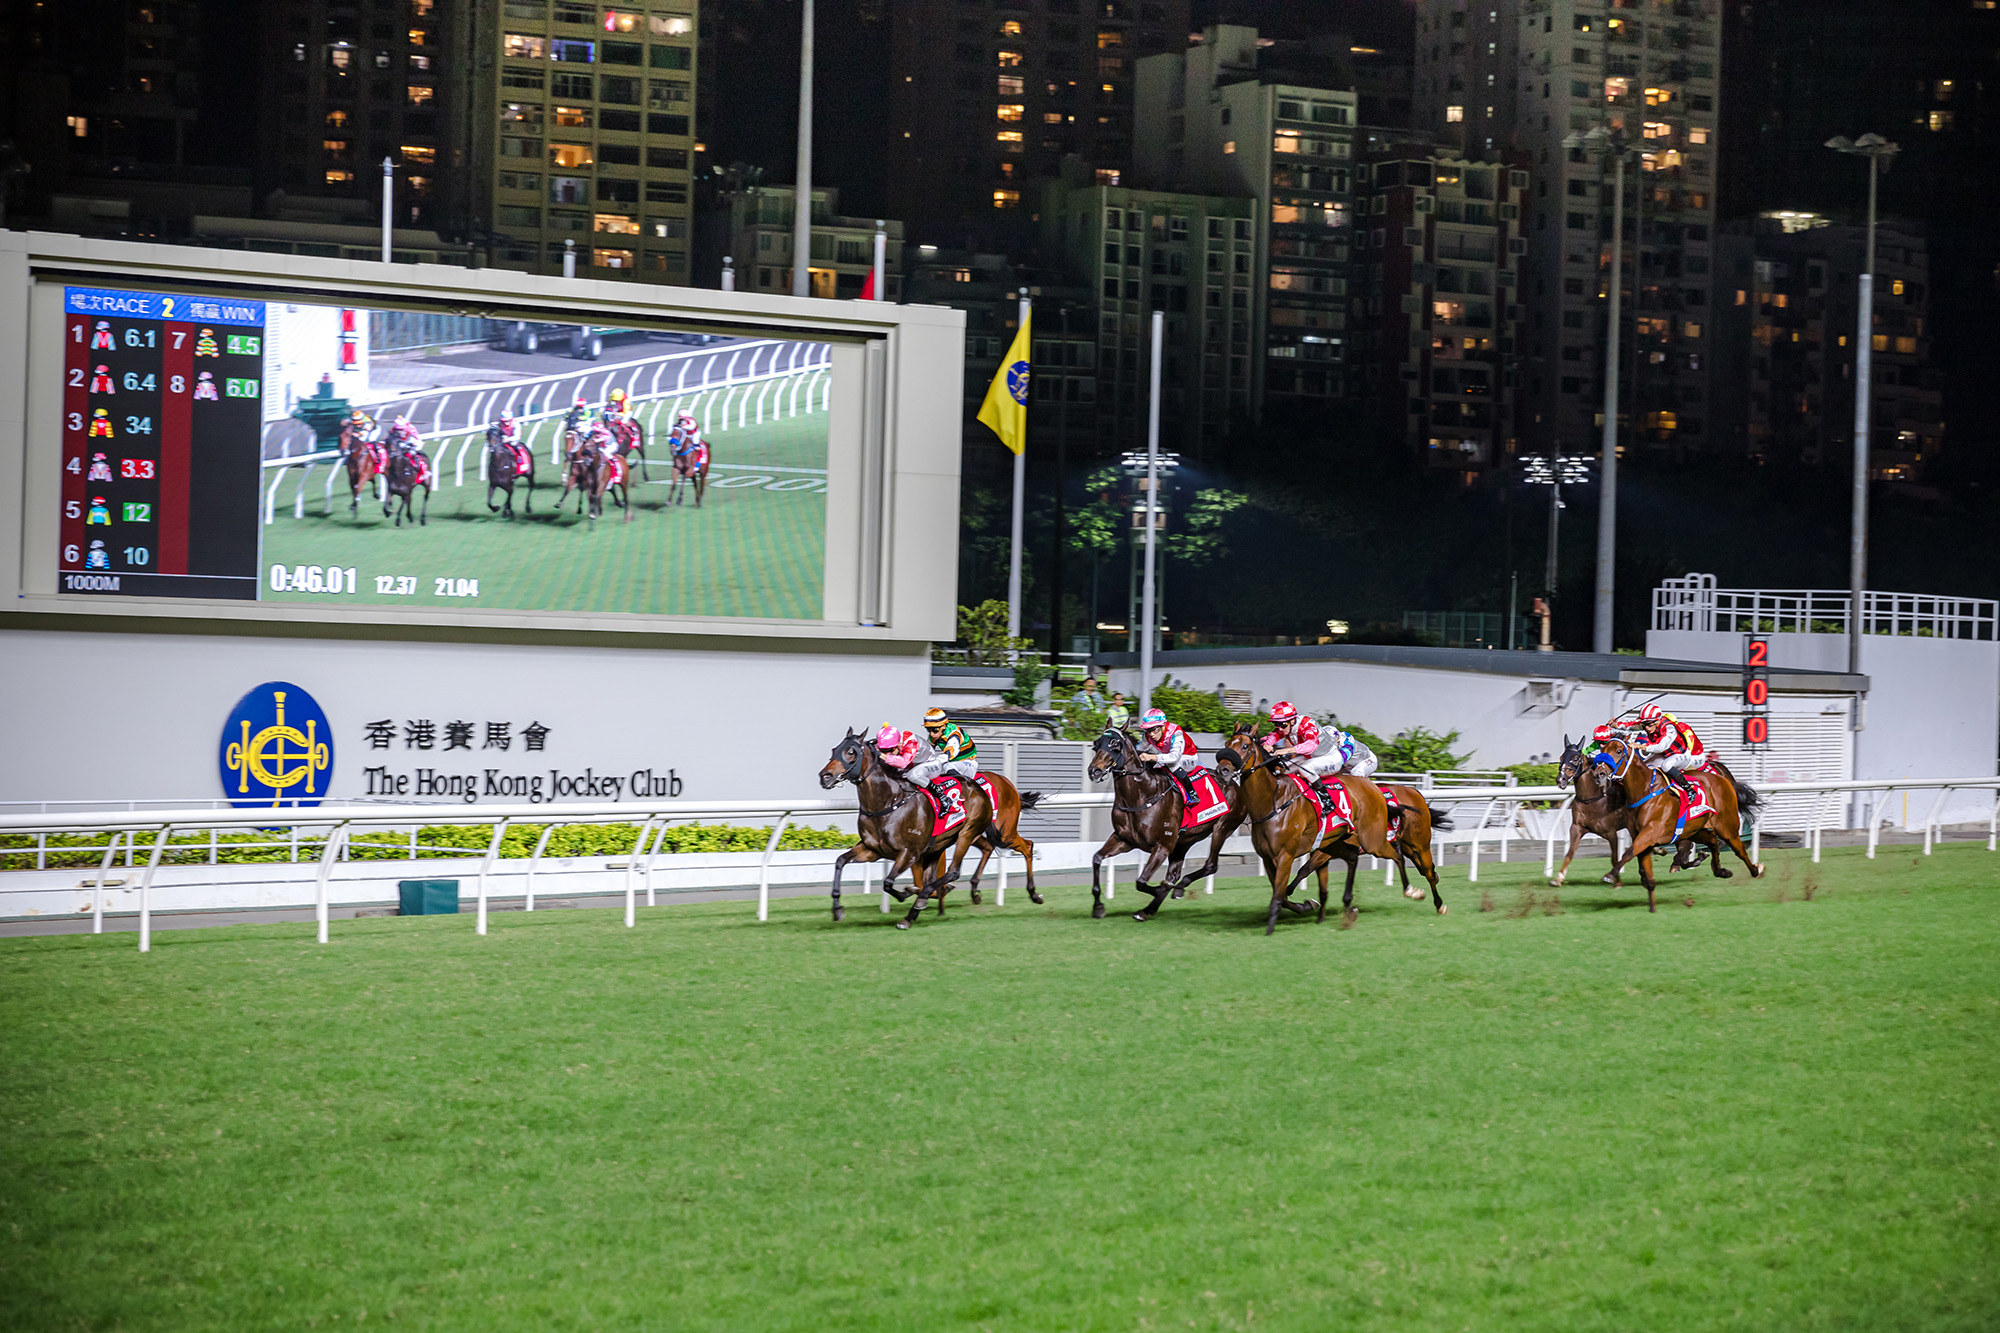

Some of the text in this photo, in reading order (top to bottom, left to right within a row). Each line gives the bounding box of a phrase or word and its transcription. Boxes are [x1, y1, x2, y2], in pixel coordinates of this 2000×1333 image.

[103, 297, 150, 314] RACE
[161, 298, 175, 317] 2
[222, 306, 256, 321] WIN
[72, 325, 260, 355] 1 6.1 7 4.5
[68, 368, 259, 398] 2 6.4 8 6.0
[68, 412, 152, 434] 3 34
[66, 456, 155, 478] 4 3.3
[65, 501, 151, 522] 5 12
[64, 544, 150, 566] 6 10
[64, 574, 121, 592] 1000M
[269, 563, 357, 595] 0:46.01
[374, 575, 417, 595] 12.37
[1747, 641, 1768, 743] 200
[363, 719, 552, 752] 香港賽馬會
[363, 766, 683, 804] The Hong Kong Jockey Club
[980, 783, 996, 811] 7
[1204, 776, 1220, 805] 1
[946, 788, 966, 812] 8
[1338, 791, 1352, 818] 4
